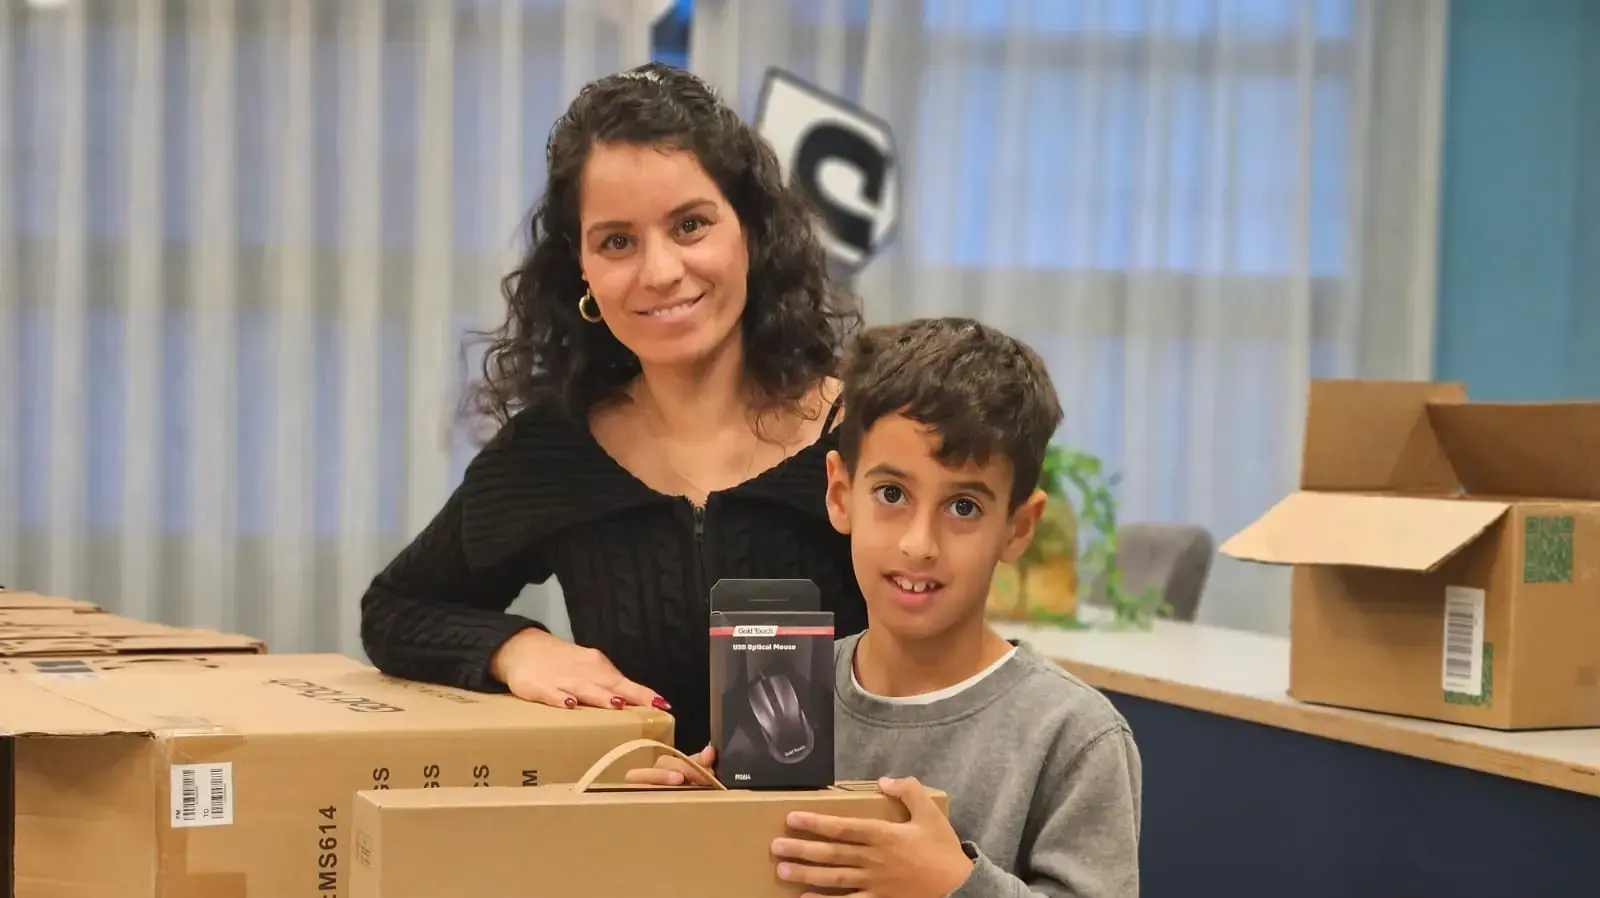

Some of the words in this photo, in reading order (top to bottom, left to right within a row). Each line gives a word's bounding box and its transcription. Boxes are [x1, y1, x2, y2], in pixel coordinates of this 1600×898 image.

[738, 627, 753, 635] Gold
[755, 627, 774, 635] Touch
[732, 643, 747, 651] USB
[748, 643, 772, 652] Optical
[773, 643, 797, 651] Mouse
